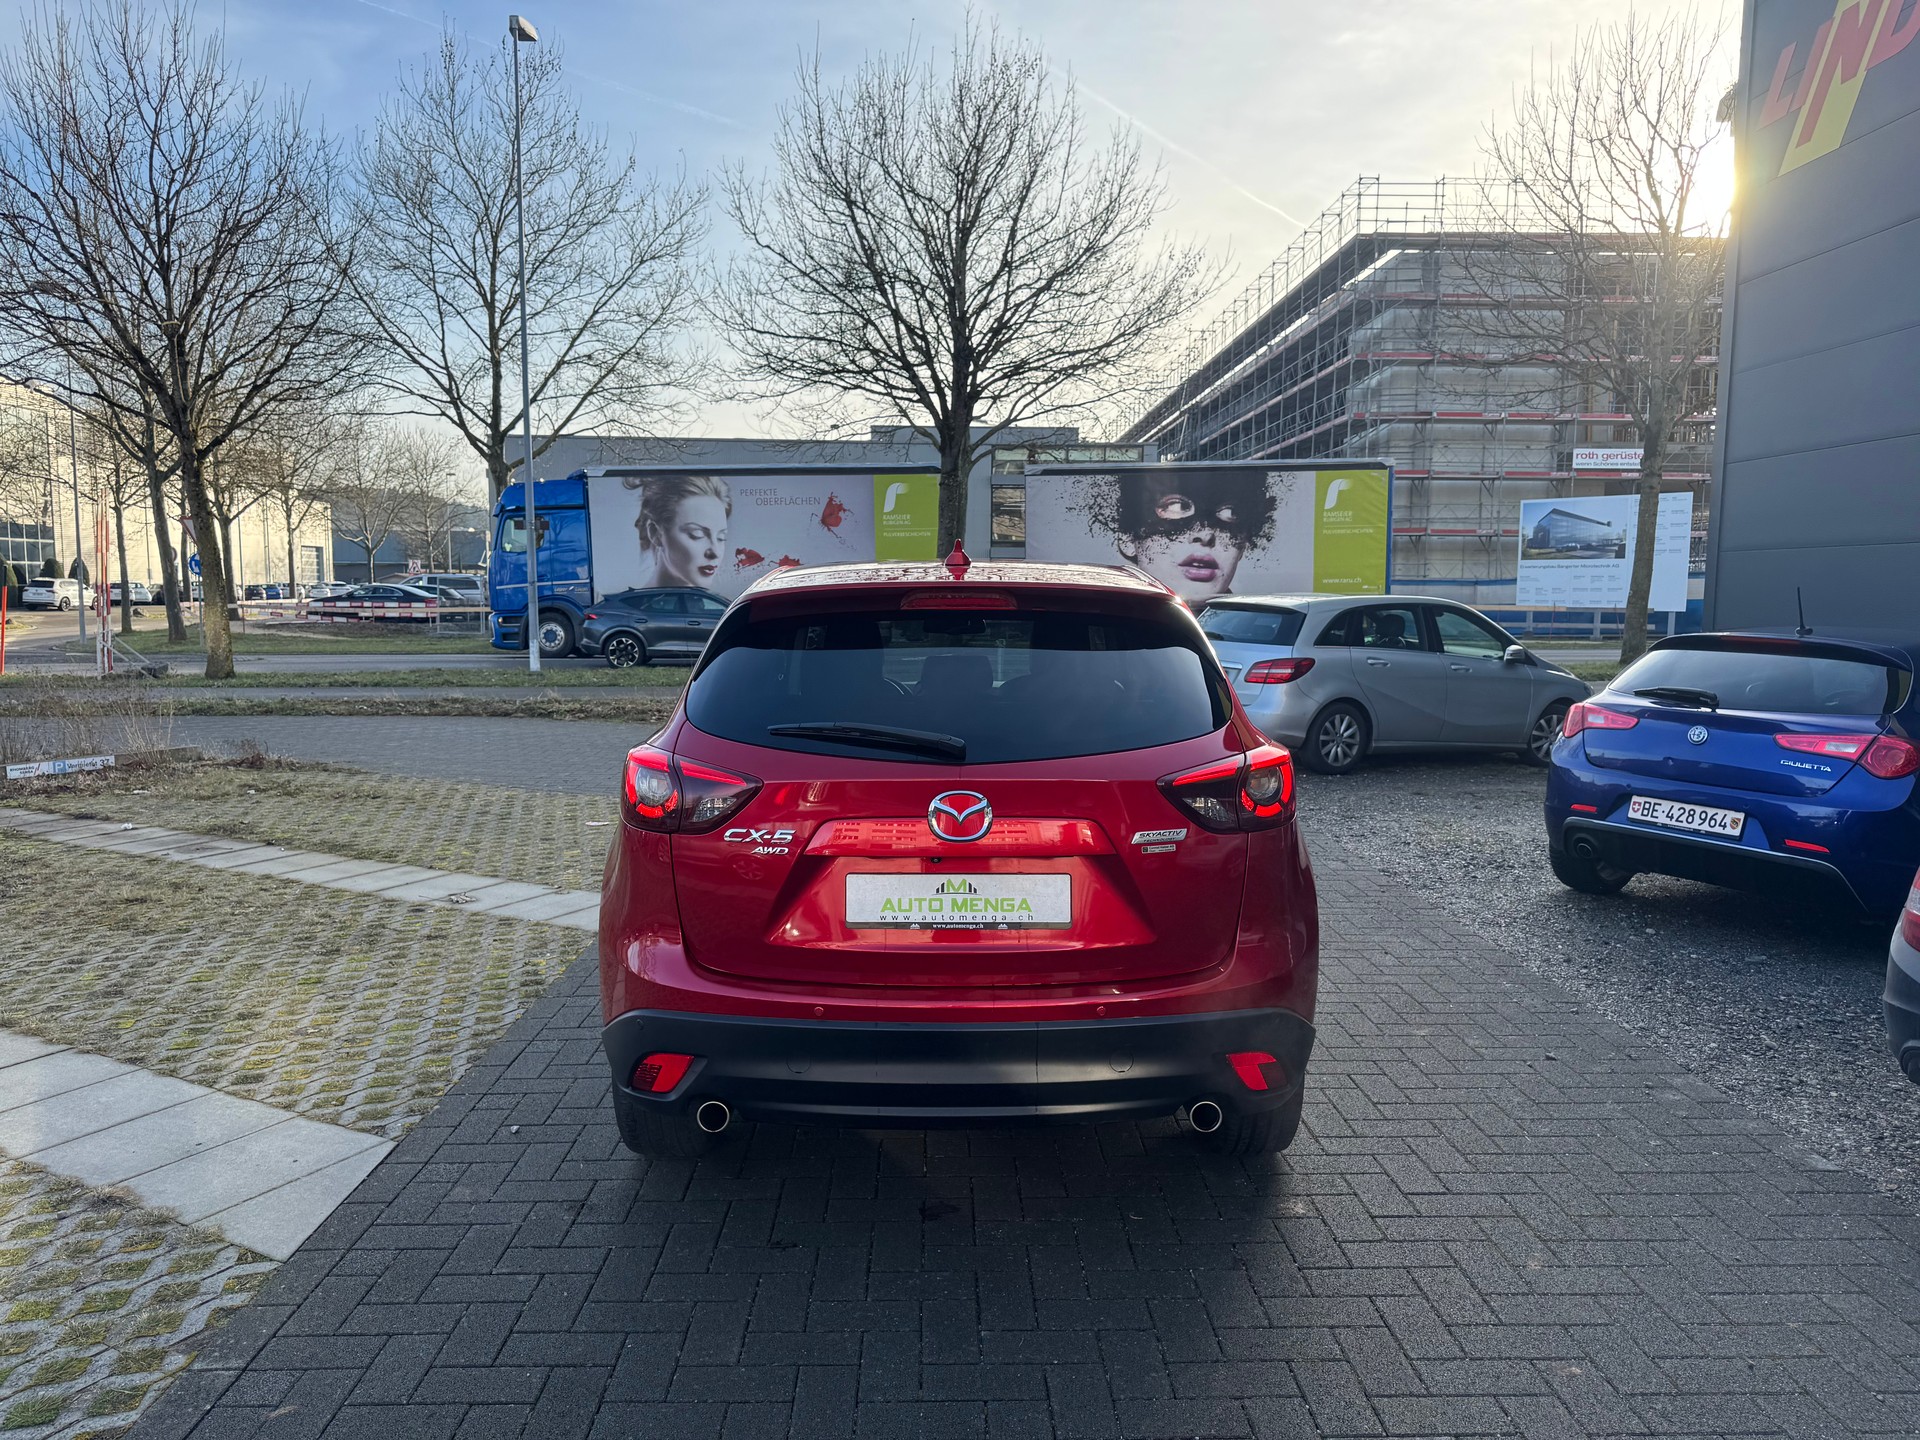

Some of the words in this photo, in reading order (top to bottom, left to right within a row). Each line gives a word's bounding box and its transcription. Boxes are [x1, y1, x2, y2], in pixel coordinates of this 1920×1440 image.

[1575, 451, 1598, 460] roth
[1601, 450, 1644, 461] gerüste
[740, 488, 778, 496] PERFEKTE
[755, 496, 821, 506] OBERFLÄCHEN
[1780, 759, 1831, 772] GIULIETTA
[724, 828, 797, 844] CX-5
[1140, 830, 1183, 838] SKYACTIV
[751, 846, 789, 855] AWD
[880, 898, 944, 913] AUTO
[951, 898, 1032, 913] MENGA
[879, 914, 1034, 922] www.automenga.ch
